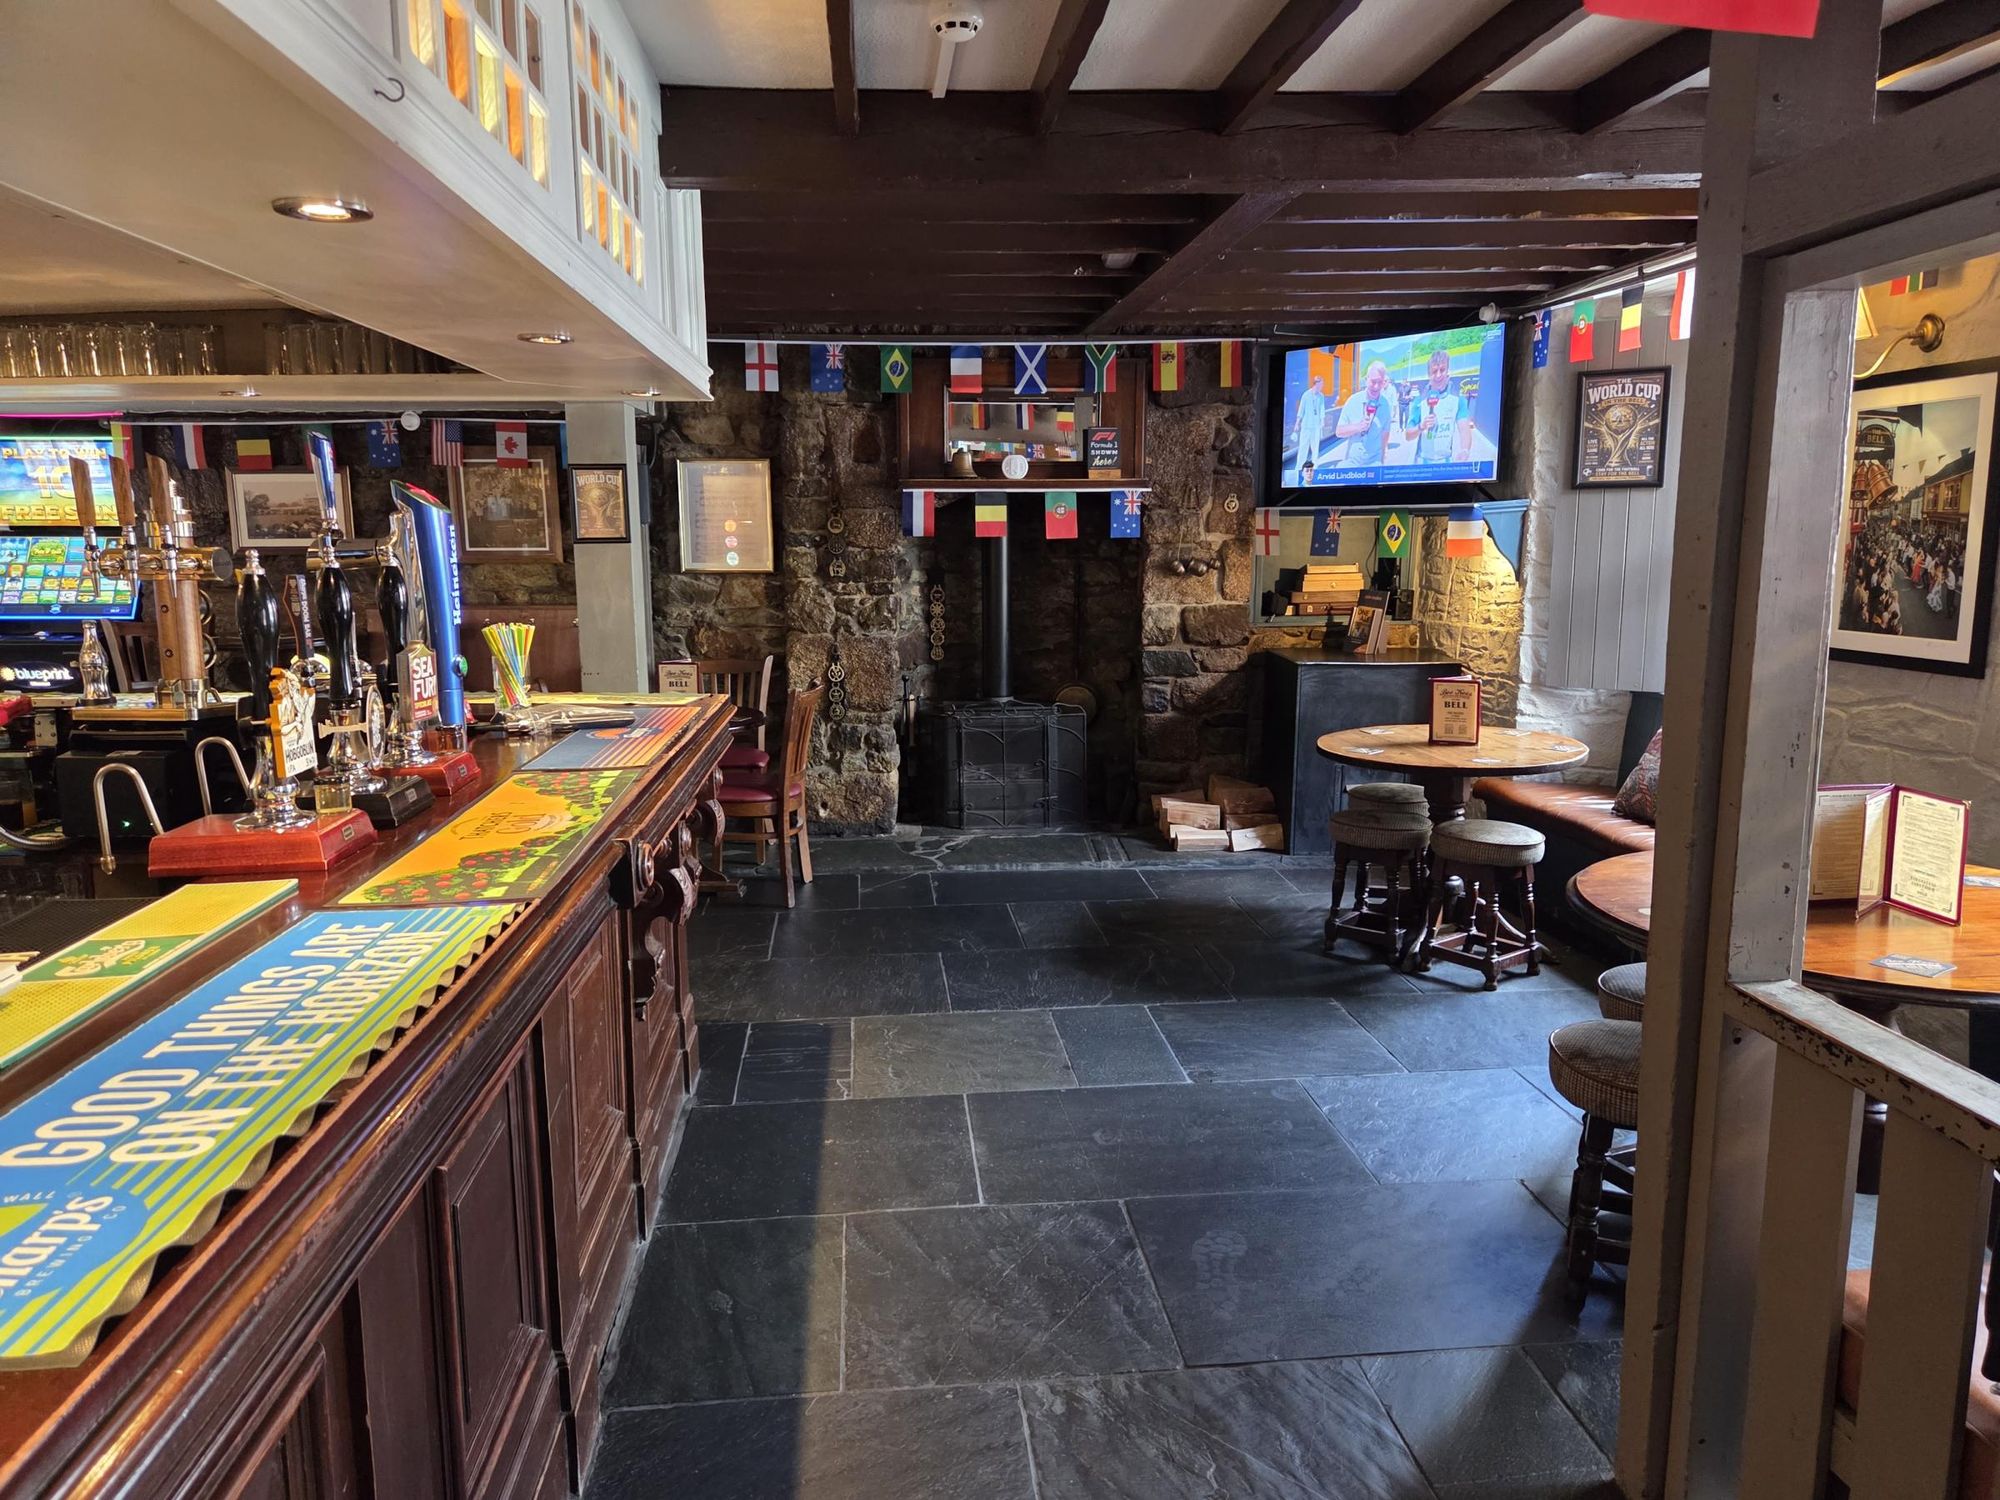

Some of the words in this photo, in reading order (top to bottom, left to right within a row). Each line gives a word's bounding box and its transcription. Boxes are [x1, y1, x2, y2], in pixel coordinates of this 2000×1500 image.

[1588, 383, 1633, 404] WORLD
[1635, 383, 1661, 400] CUP
[1090, 441, 1113, 449] Formula
[1092, 431, 1116, 441] F1
[2, 447, 45, 459] PLAY
[48, 447, 67, 458] TO
[75, 447, 107, 459] WIN
[1092, 455, 1118, 467] here!
[577, 474, 605, 487] WORLD
[1317, 472, 1335, 480] Arvid
[1336, 471, 1366, 480] Lindblad
[0, 504, 61, 520] FREE
[448, 524, 463, 626] Heineken
[301, 600, 311, 623] DOOM
[14, 667, 74, 681] blueprint
[413, 655, 434, 679] SEA
[0, 1067, 200, 1167] GOOD
[142, 964, 338, 1059] THINGS
[289, 922, 396, 958] ARE
[109, 1106, 254, 1164] ON
[189, 1031, 338, 1098] THE
[275, 930, 452, 1026] HORIZON
[0, 1196, 114, 1299] arp's
[14, 1235, 93, 1297] BREWING
[102, 1205, 127, 1220] CO
